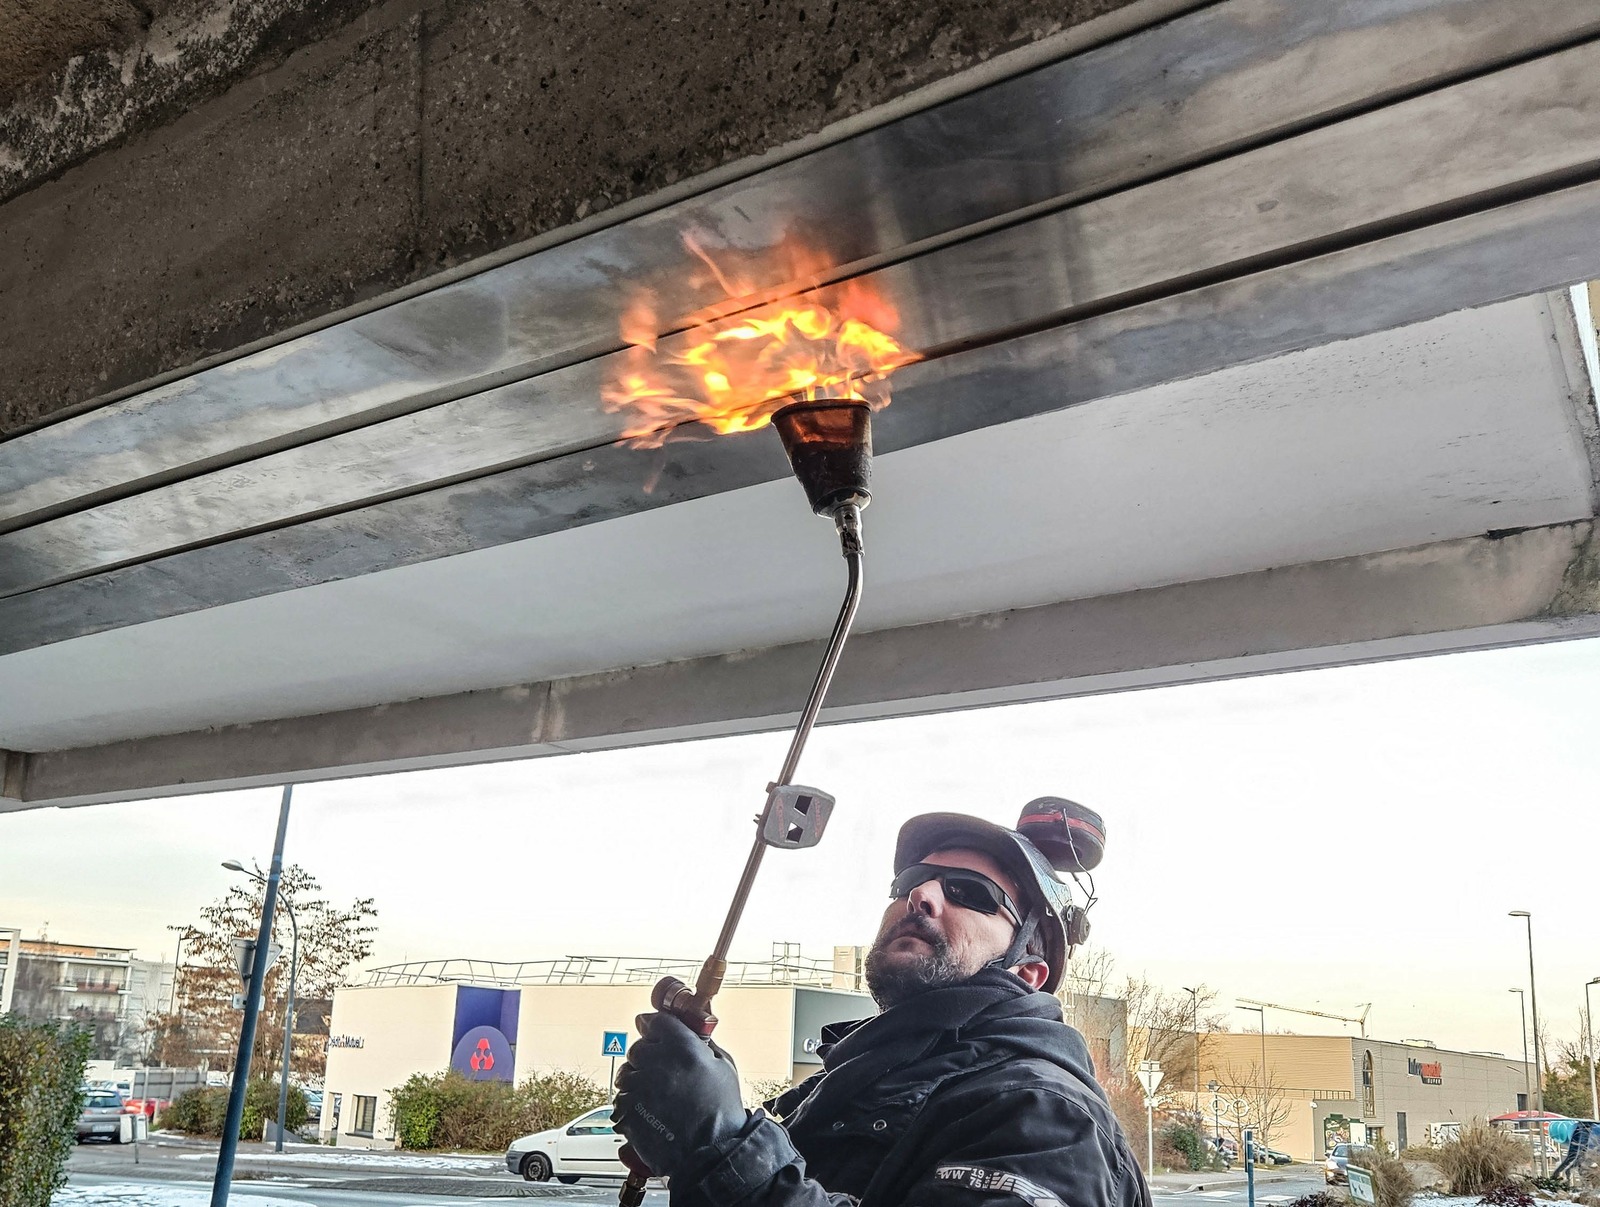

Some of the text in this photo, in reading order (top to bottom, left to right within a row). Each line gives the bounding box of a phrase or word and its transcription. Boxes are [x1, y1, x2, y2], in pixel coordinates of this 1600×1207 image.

[635, 1102, 666, 1134] SINGER
[937, 1167, 965, 1180] WW
[971, 1168, 985, 1179] 19
[969, 1176, 983, 1188] 75
